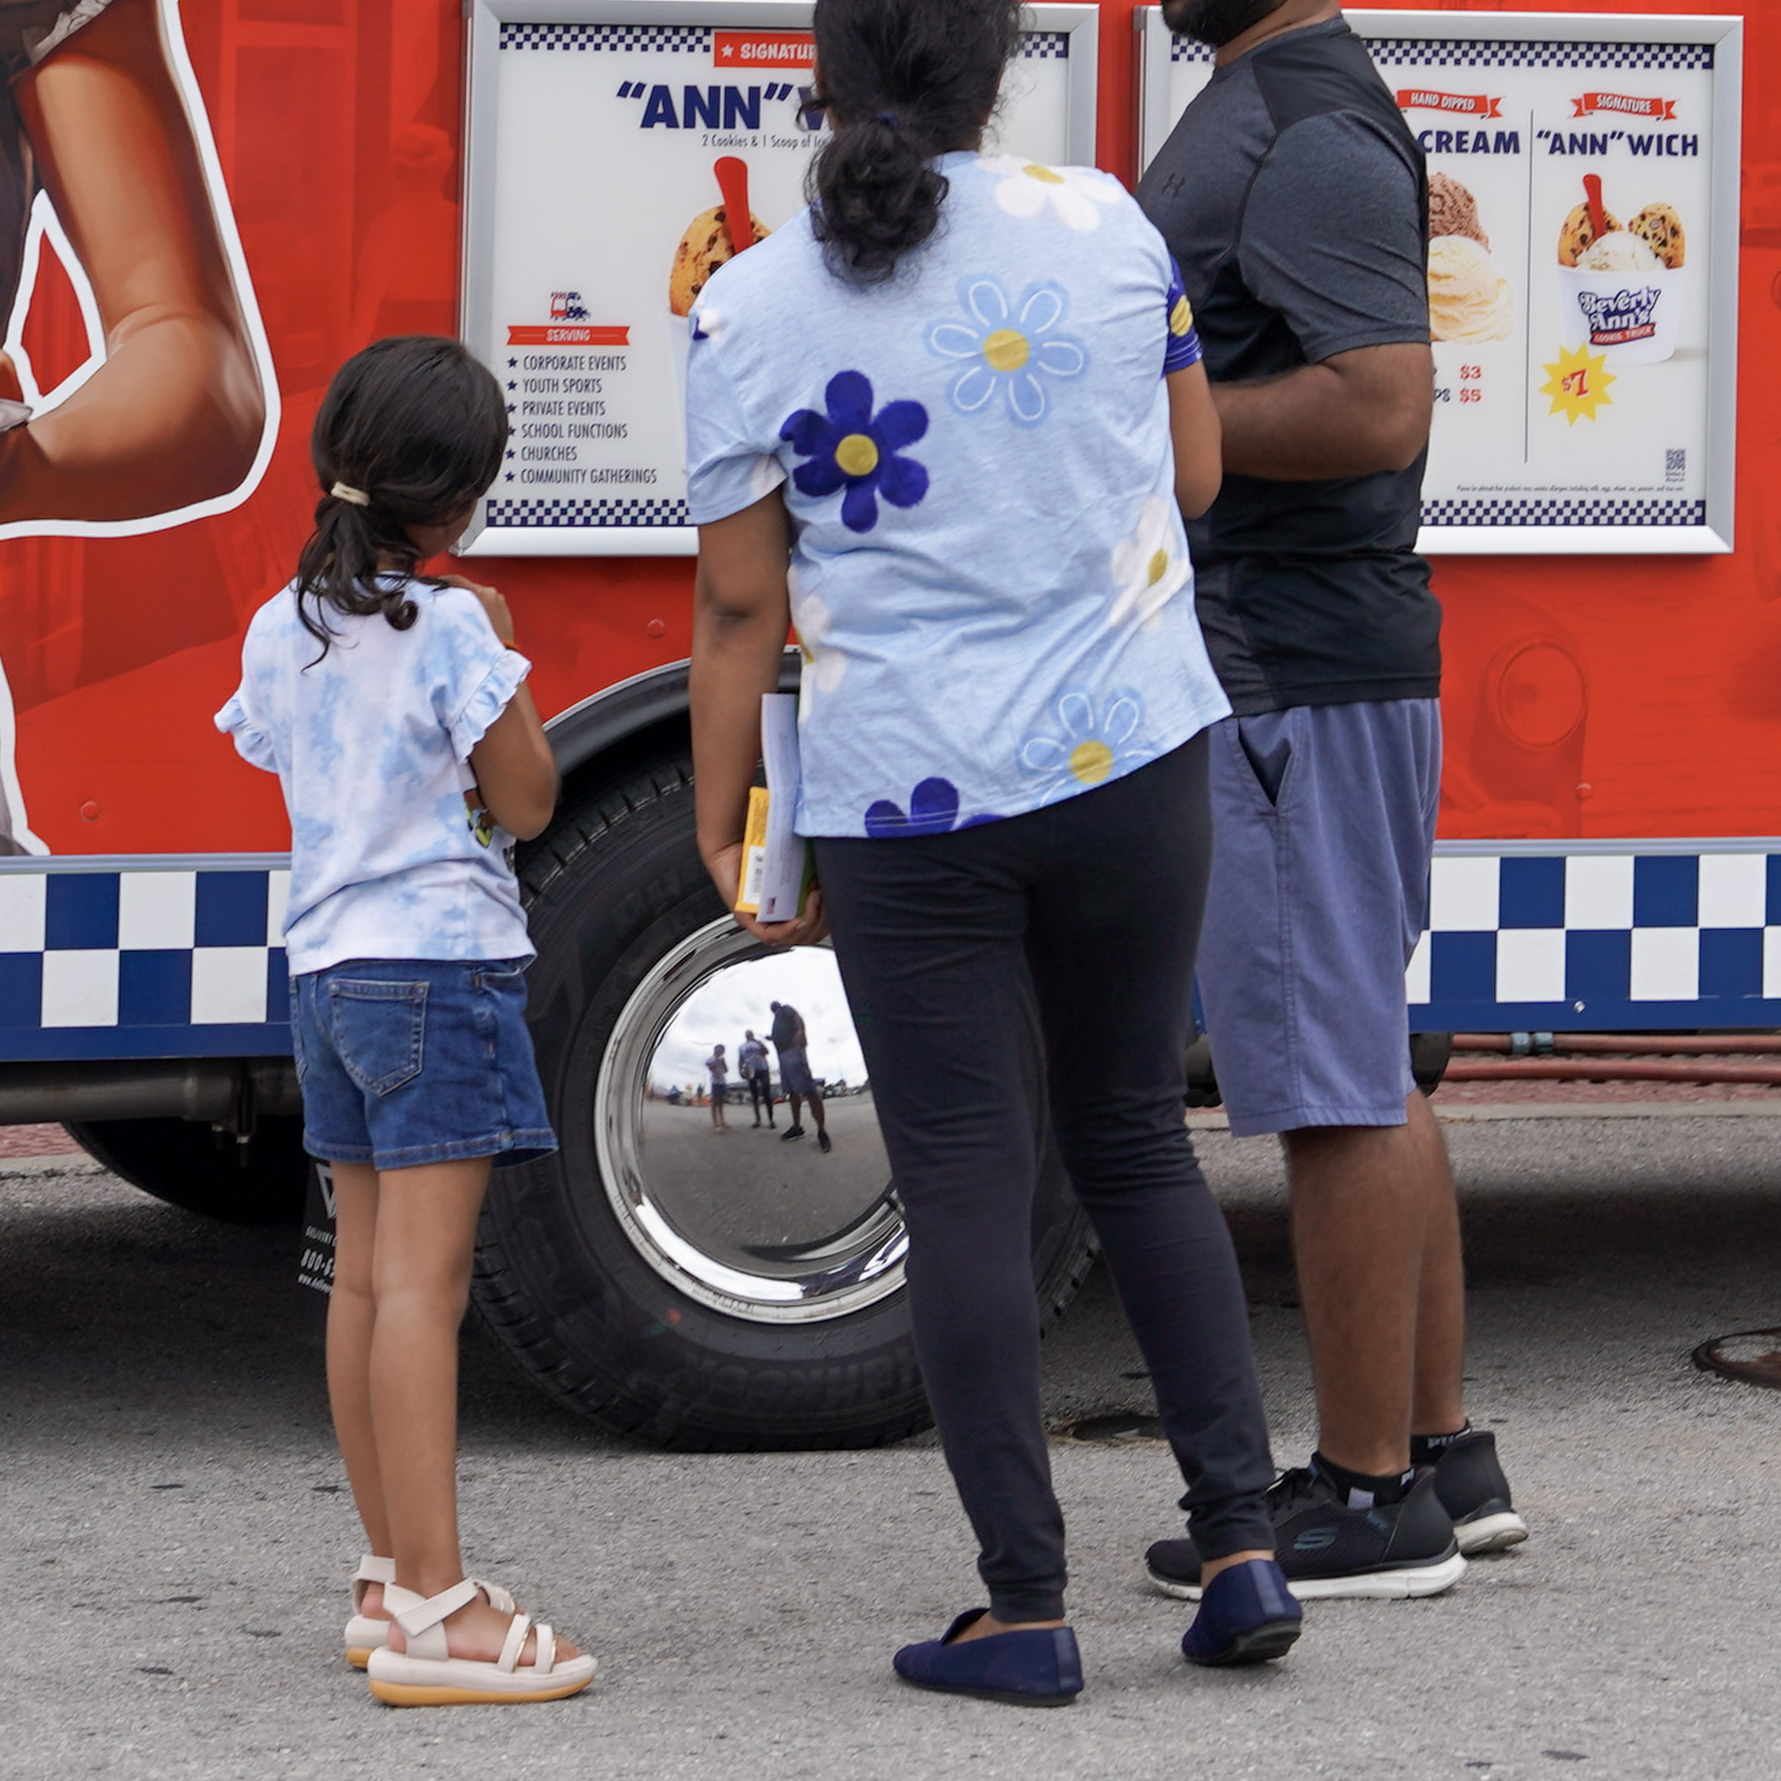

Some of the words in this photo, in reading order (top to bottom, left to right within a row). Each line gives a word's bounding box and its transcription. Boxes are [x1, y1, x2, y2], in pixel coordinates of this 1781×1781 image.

[740, 43, 815, 60] SIGNATUR
[617, 81, 832, 130] "ANN"
[1411, 92, 1439, 107] HAND
[1441, 96, 1475, 112] DIPPED
[1596, 94, 1652, 114] SIGNATURE
[702, 134, 709, 146] 2
[712, 134, 748, 148] Cookies
[771, 134, 798, 150] Scoop
[802, 134, 811, 148] of
[1419, 130, 1520, 155] CREAM
[546, 329, 591, 342] SERVING
[523, 355, 585, 371] CORPORATE
[588, 356, 627, 371] EVENTS
[1460, 364, 1482, 381] $3
[523, 378, 559, 393] YOUTH
[563, 378, 602, 393] SPORTS
[1561, 370, 1589, 398] $7
[1460, 387, 1482, 404] $5
[522, 401, 564, 416] PRIVATE
[568, 401, 606, 416] EVENTS
[521, 423, 564, 438] SCHOOL
[568, 423, 628, 439] FUNCTIONS
[521, 446, 577, 461] CHURCHES
[520, 468, 587, 484] COMMUNITY
[590, 468, 658, 484] GATHERINGS
